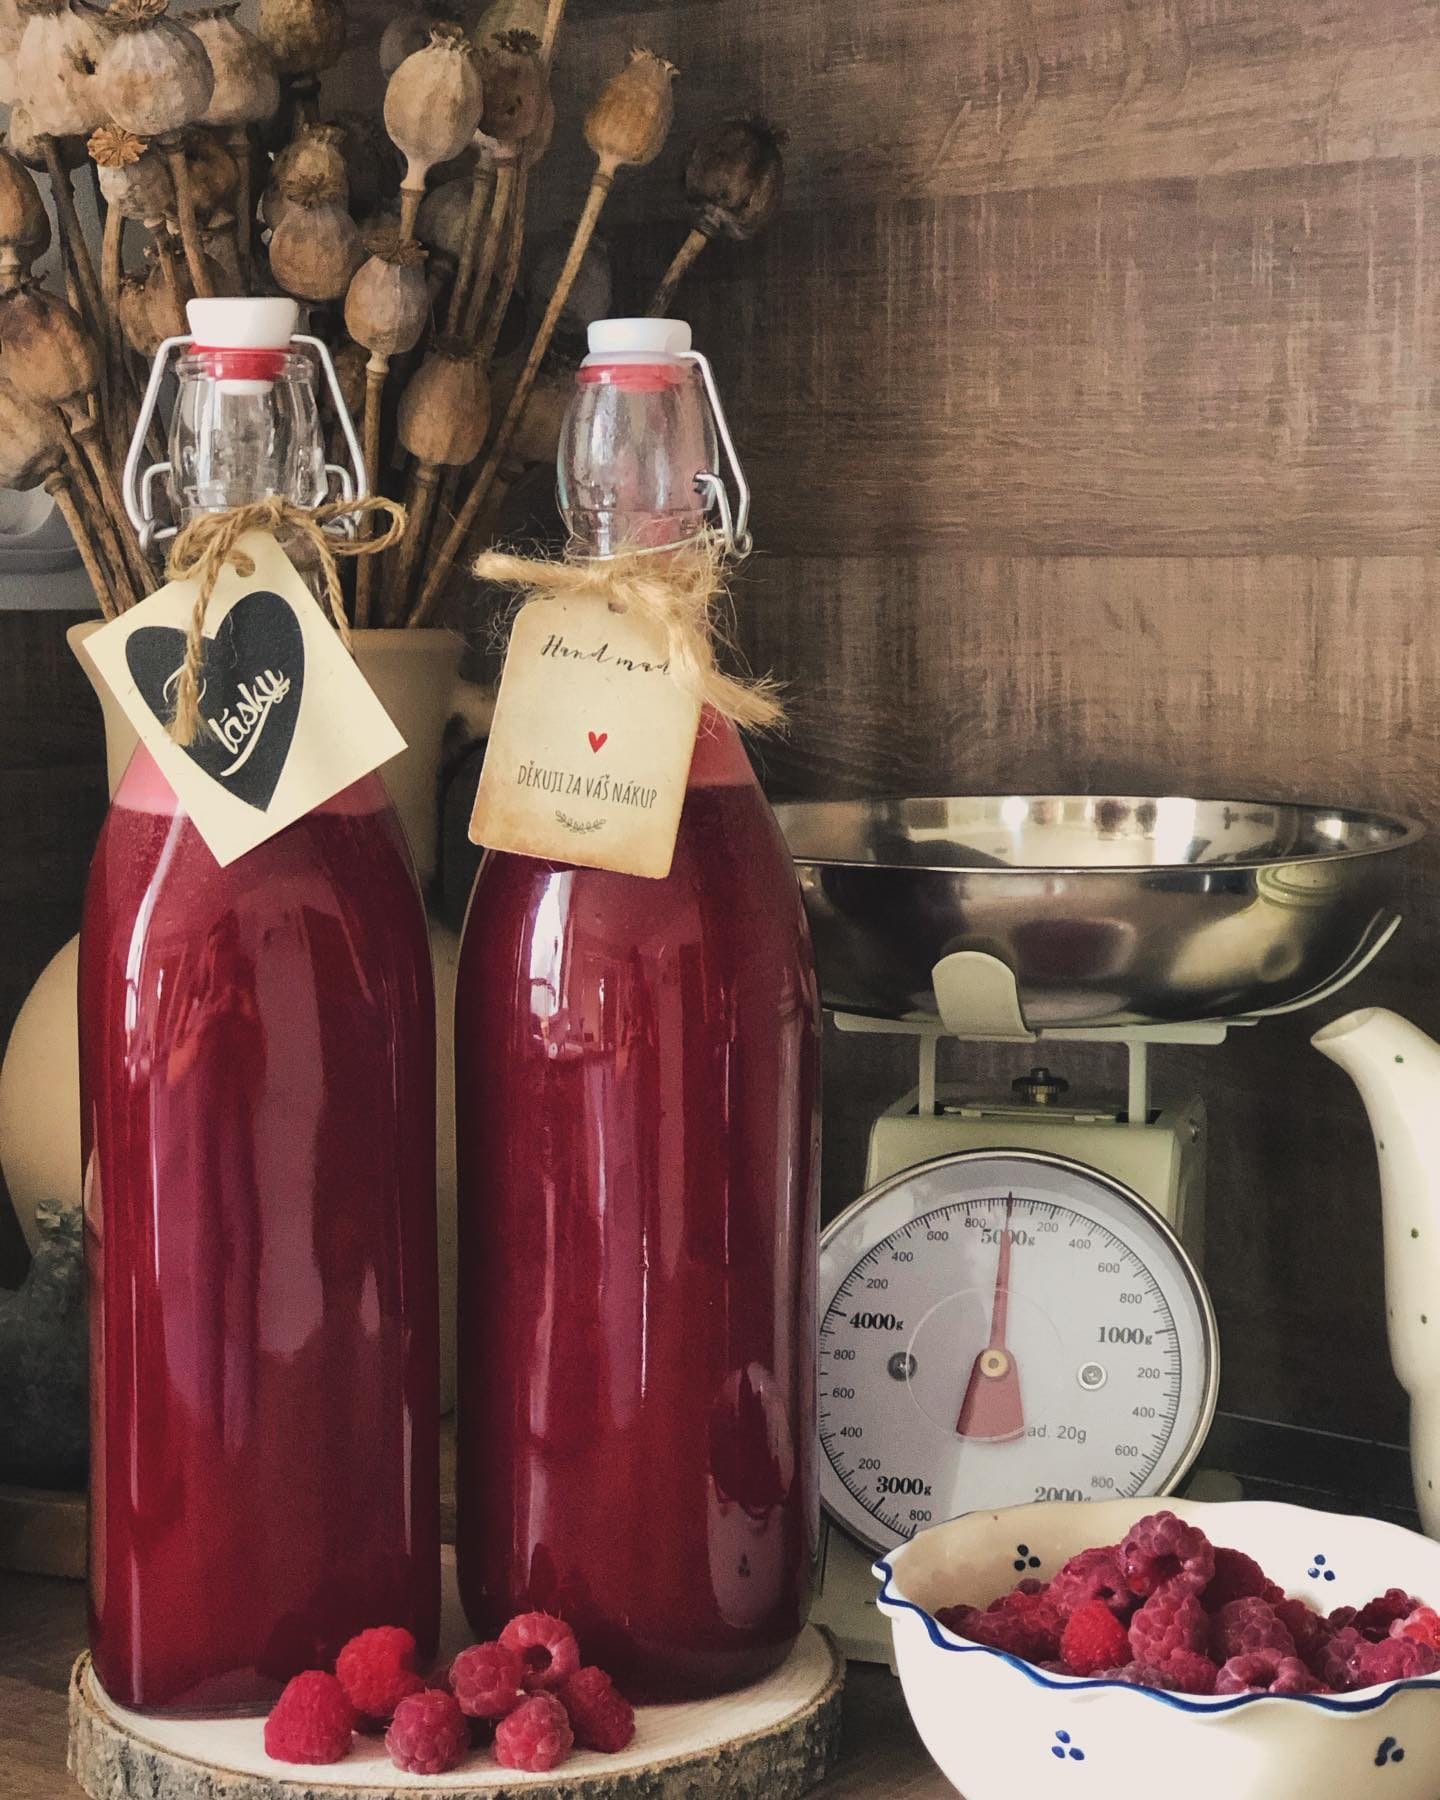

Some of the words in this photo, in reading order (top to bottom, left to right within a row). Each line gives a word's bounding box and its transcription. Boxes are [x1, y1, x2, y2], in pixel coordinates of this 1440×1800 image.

[541, 634, 614, 663] Hand
[616, 656, 671, 676] mad
[207, 669, 291, 776] lásku
[517, 759, 564, 793] DĚKUJI
[565, 773, 581, 796] ZA
[585, 773, 610, 801] VÁŠ
[612, 780, 658, 809] NÁKUP
[964, 1217, 987, 1229] 800
[1036, 1221, 1060, 1233] 200
[927, 1230, 949, 1242] 600
[1068, 1238, 1091, 1250] 400
[891, 1251, 914, 1263] 400
[1098, 1262, 1120, 1274] 600
[866, 1278, 889, 1290] 200
[1120, 1293, 1143, 1305] 800
[849, 1312, 904, 1332] 4000g
[1097, 1326, 1153, 1346] 1000g
[833, 1349, 856, 1361] 800
[1137, 1367, 1160, 1379] 200
[832, 1388, 855, 1400] 600
[1132, 1407, 1155, 1419] 400
[840, 1426, 863, 1438] 400
[1056, 1424, 1087, 1445] 20g
[1114, 1445, 1138, 1457] 600
[858, 1458, 881, 1470] 200
[876, 1475, 932, 1496] 3000g
[1090, 1476, 1114, 1489] 800
[909, 1509, 932, 1521] 800
